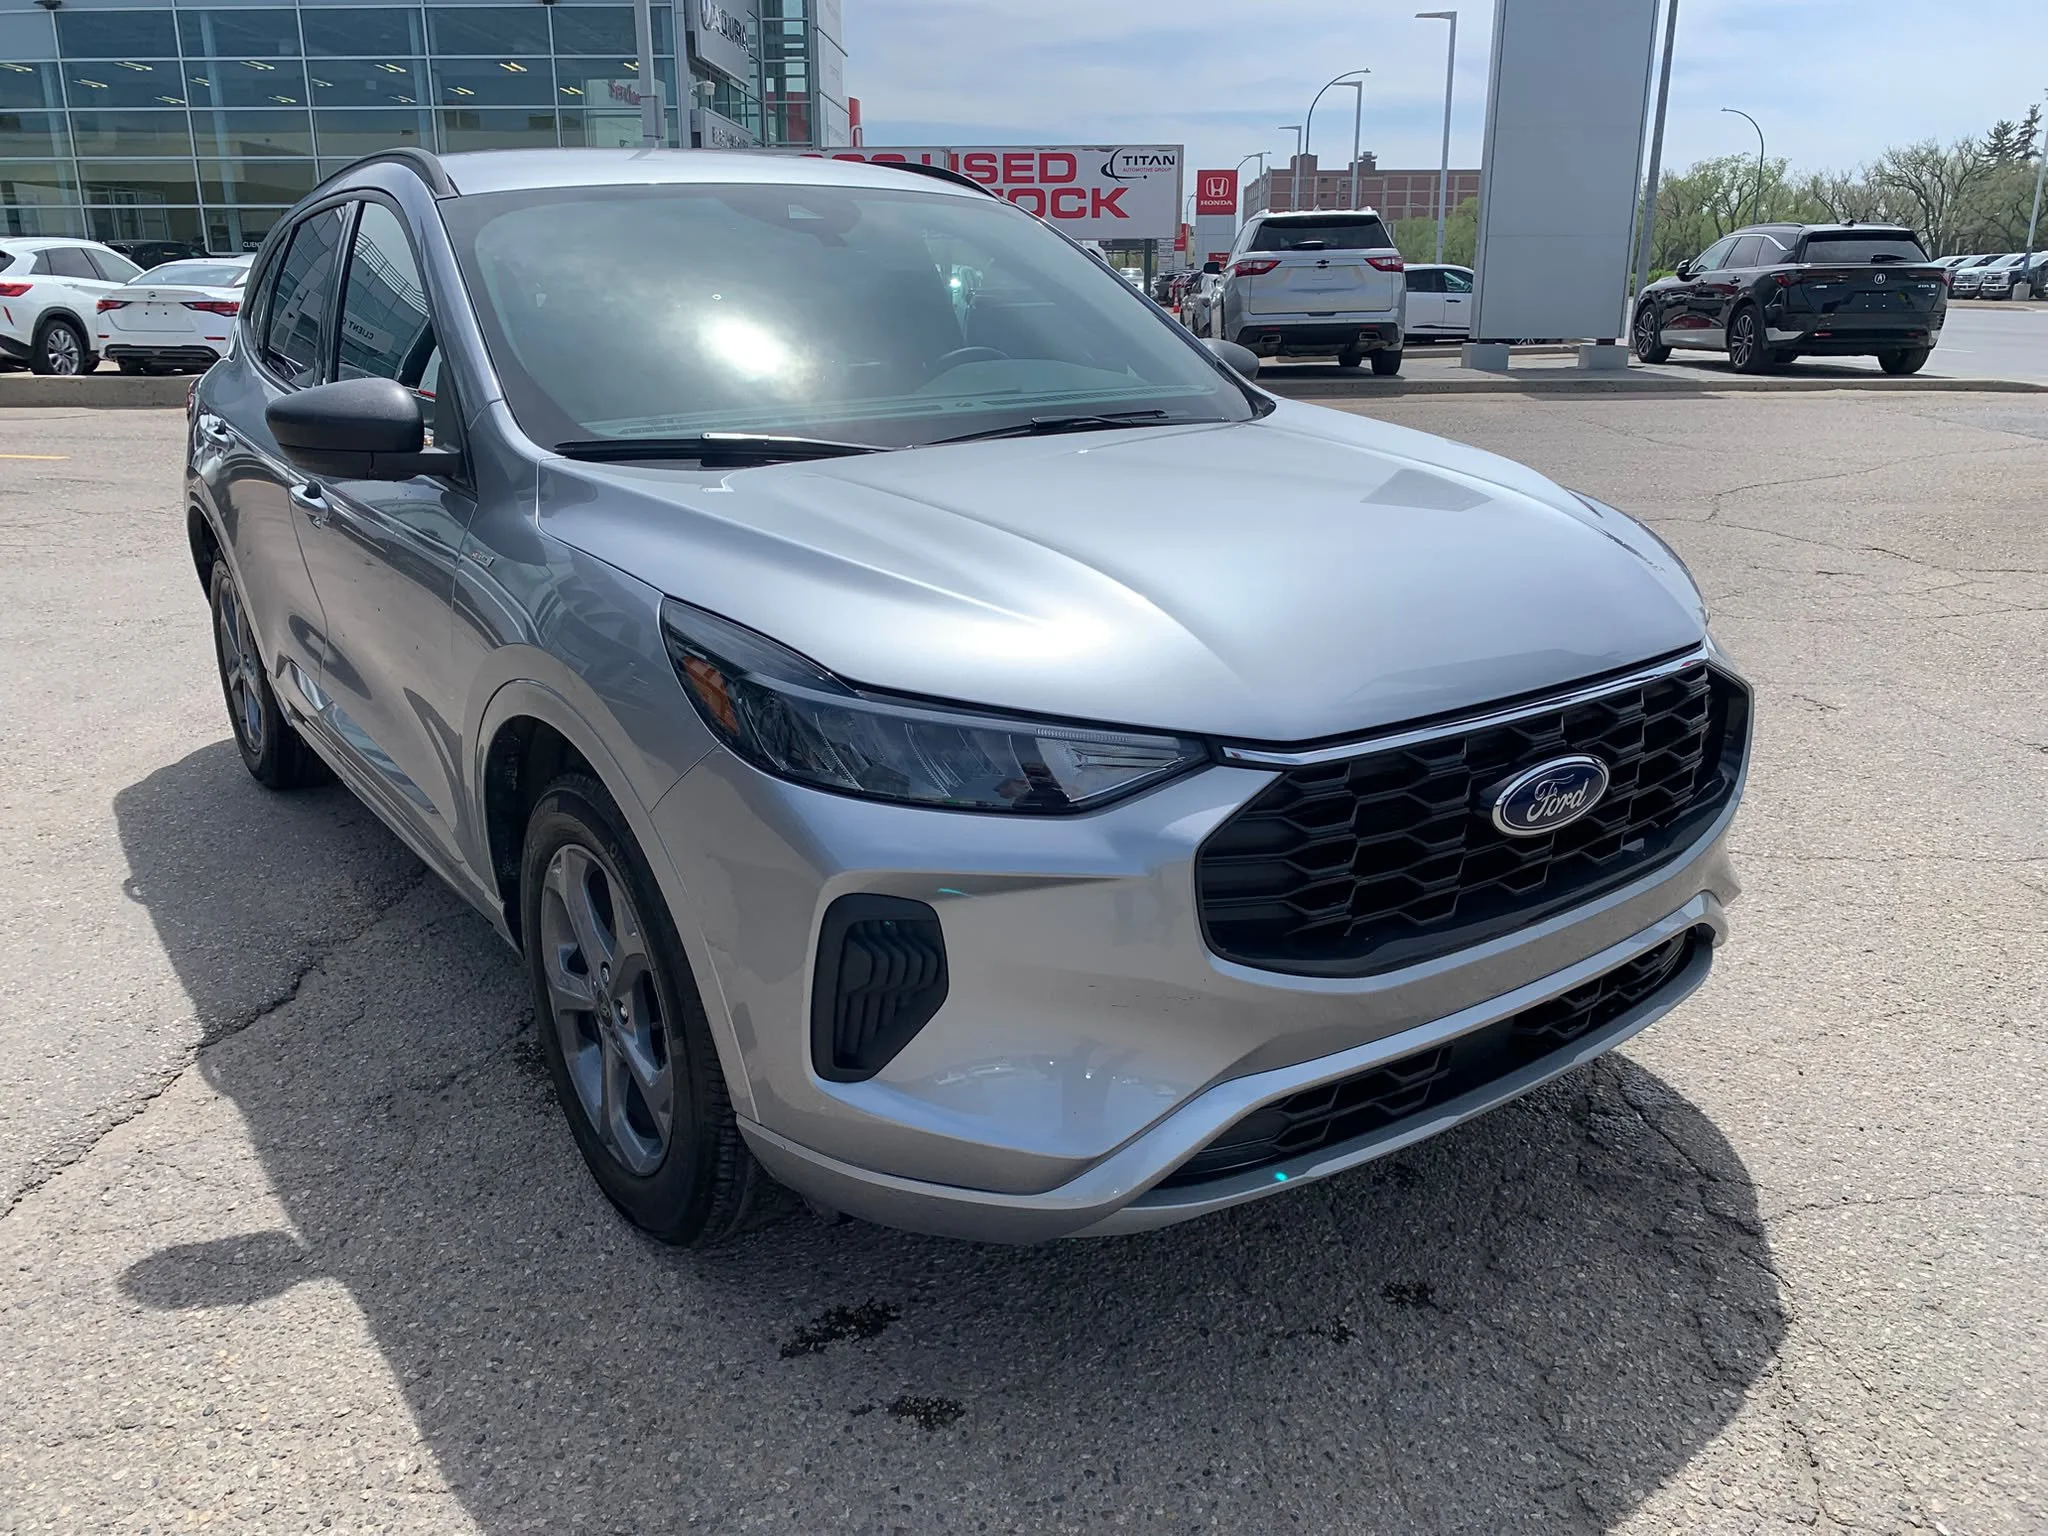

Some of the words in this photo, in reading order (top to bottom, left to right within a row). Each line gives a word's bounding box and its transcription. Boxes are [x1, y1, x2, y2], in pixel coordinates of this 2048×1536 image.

[710, 4, 749, 52] ACURA
[1122, 155, 1175, 166] TITAN
[990, 188, 1130, 218] OCK
[1526, 773, 1590, 822] Ford
